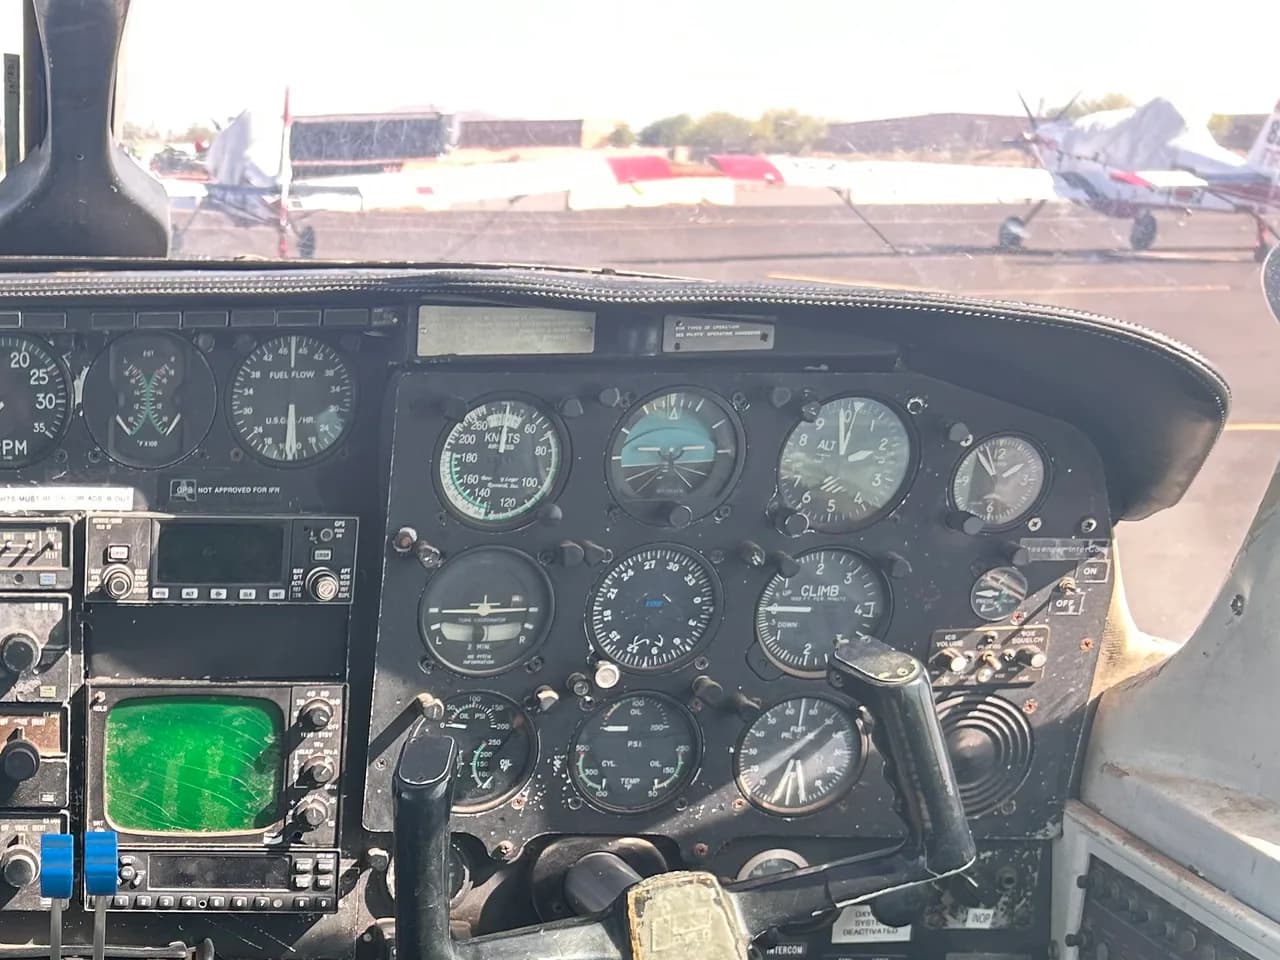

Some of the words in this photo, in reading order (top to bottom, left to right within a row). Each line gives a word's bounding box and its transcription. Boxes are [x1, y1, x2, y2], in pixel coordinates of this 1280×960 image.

[10, 352, 30, 368] 20
[30, 368, 48, 384] 25
[250, 370, 260, 378] 38
[36, 393, 56, 409] 30
[33, 422, 46, 432] 35
[524, 424, 536, 434] 60
[816, 418, 824, 430] 9
[458, 434, 476, 444] 200
[798, 434, 808, 446] 8
[879, 438, 888, 451] 2
[534, 446, 546, 456] 80
[817, 440, 836, 452] ALT
[462, 454, 478, 462] 180
[462, 474, 479, 484] 160
[521, 478, 538, 488] 100
[794, 474, 802, 488] 7
[872, 473, 882, 487] 3
[474, 488, 490, 498] 140
[802, 490, 811, 504] 6
[854, 492, 864, 504] 4
[500, 498, 516, 508] 120
[826, 499, 836, 512] 5
[986, 501, 994, 513] 6
[644, 560, 656, 570] 27
[666, 562, 679, 572] 30
[816, 564, 824, 575] 2
[621, 569, 634, 581] 24
[684, 574, 696, 586] 33
[844, 572, 852, 584] 3
[606, 588, 618, 600] 21
[800, 585, 840, 596] CLIMB
[602, 610, 612, 621] 18
[854, 604, 862, 616] 4
[436, 636, 442, 644] L
[518, 636, 526, 644] R
[608, 630, 621, 642] 15
[803, 643, 812, 654] 2
[842, 928, 898, 936] DEACTIVATED
